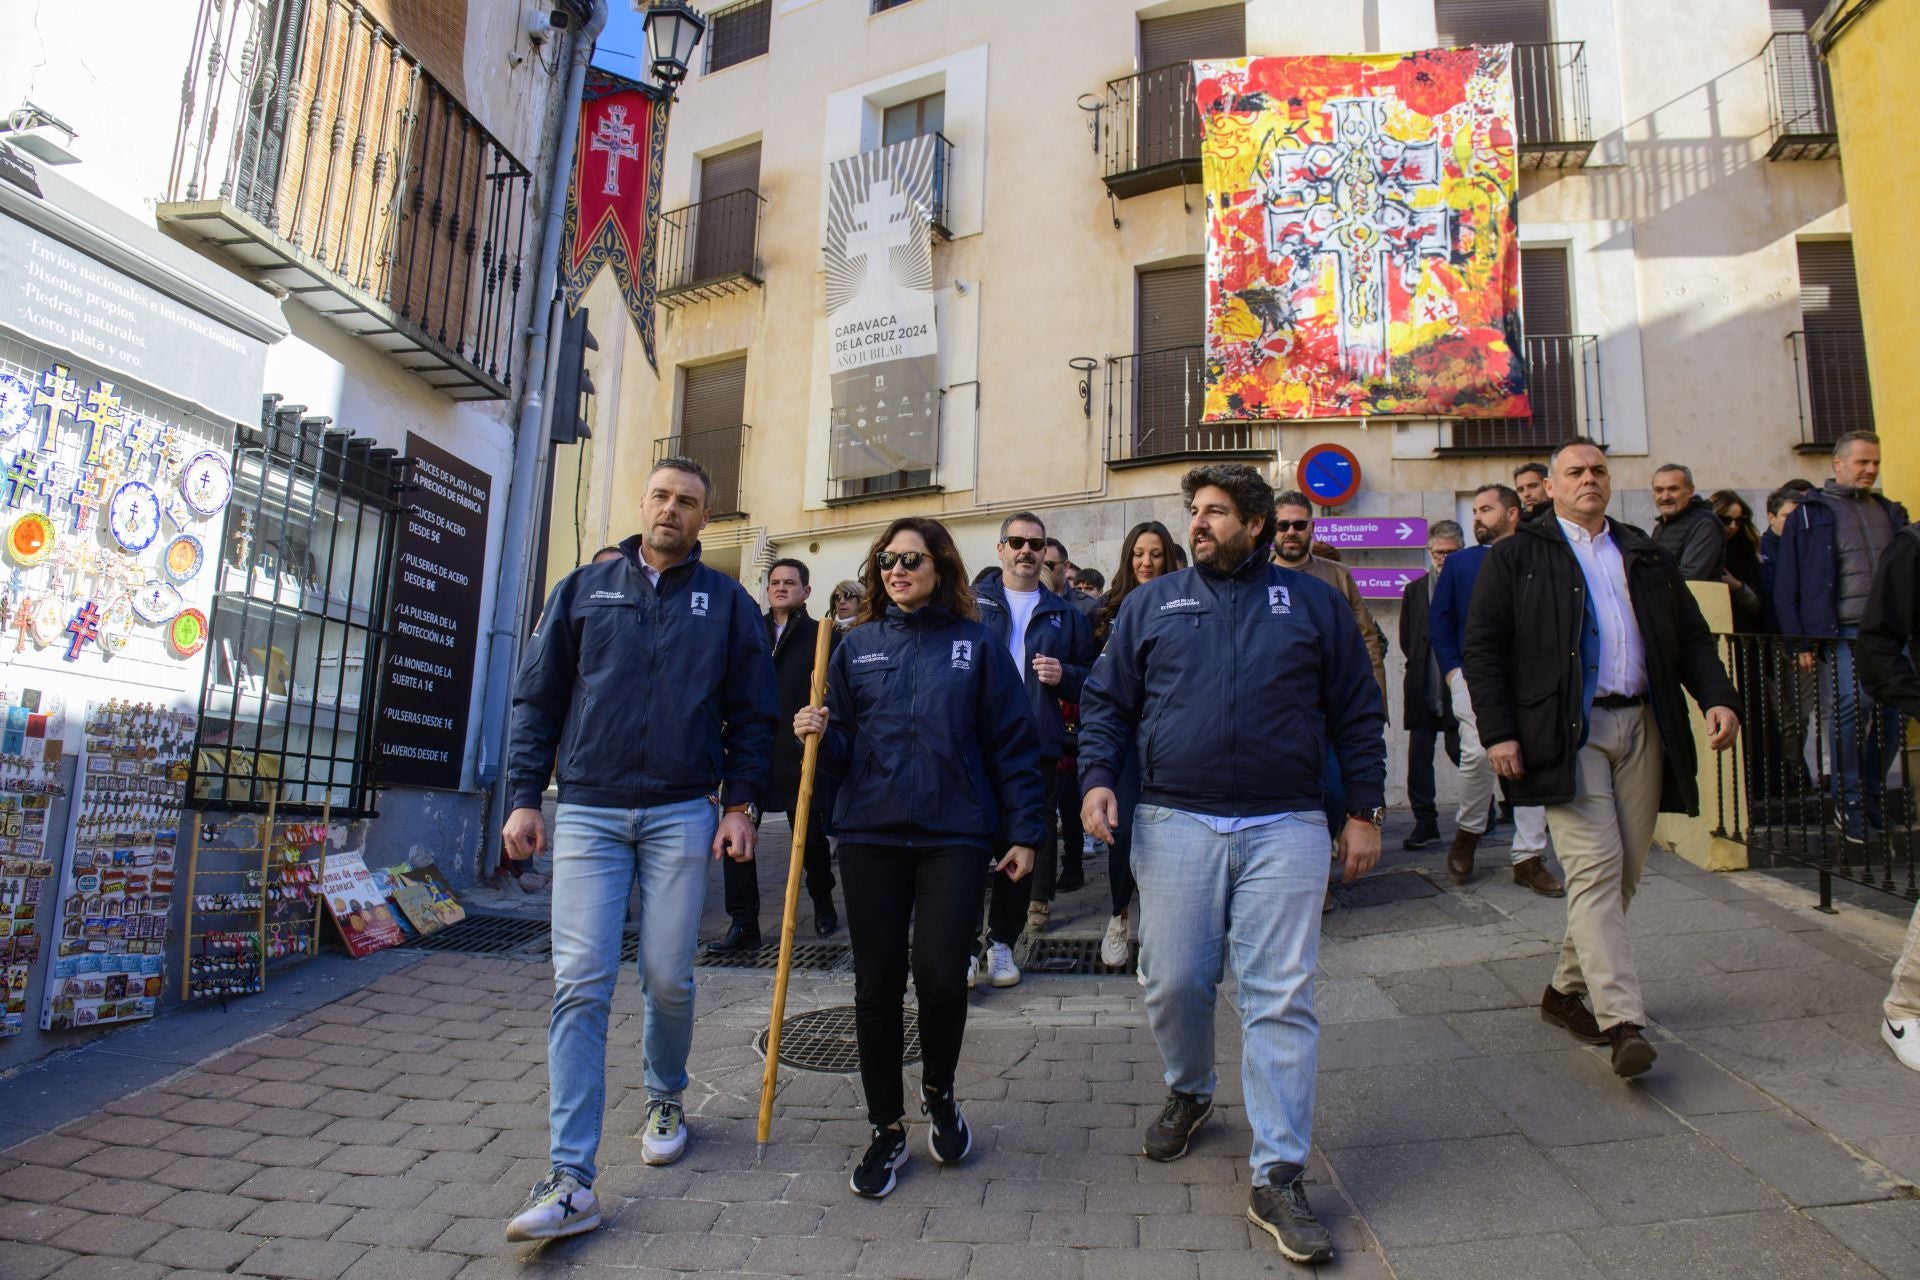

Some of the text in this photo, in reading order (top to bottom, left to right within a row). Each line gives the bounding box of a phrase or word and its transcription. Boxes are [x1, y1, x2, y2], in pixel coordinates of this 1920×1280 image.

[80, 267, 147, 307] nacionales
[150, 301, 158, 312] e
[85, 291, 137, 324] propios.
[83, 312, 148, 350] naturales.
[835, 315, 897, 337] CARAVACA
[71, 328, 105, 352] plata
[106, 344, 117, 359] y
[119, 350, 143, 368] oro.
[836, 324, 928, 353] DE LA CRUZ 2024
[837, 343, 903, 368] AÑO JUBILAR
[419, 475, 447, 497] PRECIOS
[447, 489, 456, 502] DE
[456, 494, 482, 515] FÁBRICA
[440, 470, 449, 482] DE
[449, 475, 467, 494] PLATA
[472, 487, 486, 501] ORO
[409, 521, 441, 544] DESDE 5€
[436, 515, 446, 528] DE
[445, 520, 466, 537] ACERO
[1315, 533, 1364, 542] Vera Cruz
[1330, 523, 1378, 533] Santuario
[404, 571, 436, 592] DESDE 8€
[438, 566, 448, 578] DE
[447, 571, 469, 586] ACERO
[1369, 578, 1392, 588] Cruz
[410, 606, 438, 625] PULSERA
[439, 616, 448, 628] DE
[448, 620, 457, 631] LA
[398, 621, 440, 645] PROTECCIÓN
[445, 636, 455, 648] 5€
[404, 656, 434, 674] MONEDA
[434, 664, 443, 677] DE
[443, 667, 452, 679] LA
[391, 673, 417, 689] SUERTE
[424, 680, 434, 692] 1€
[422, 714, 443, 728] DESDE
[444, 719, 454, 730] 1€
[383, 743, 449, 763] LLAVEROS DESDE 1€
[324, 881, 355, 894] Caravaca
